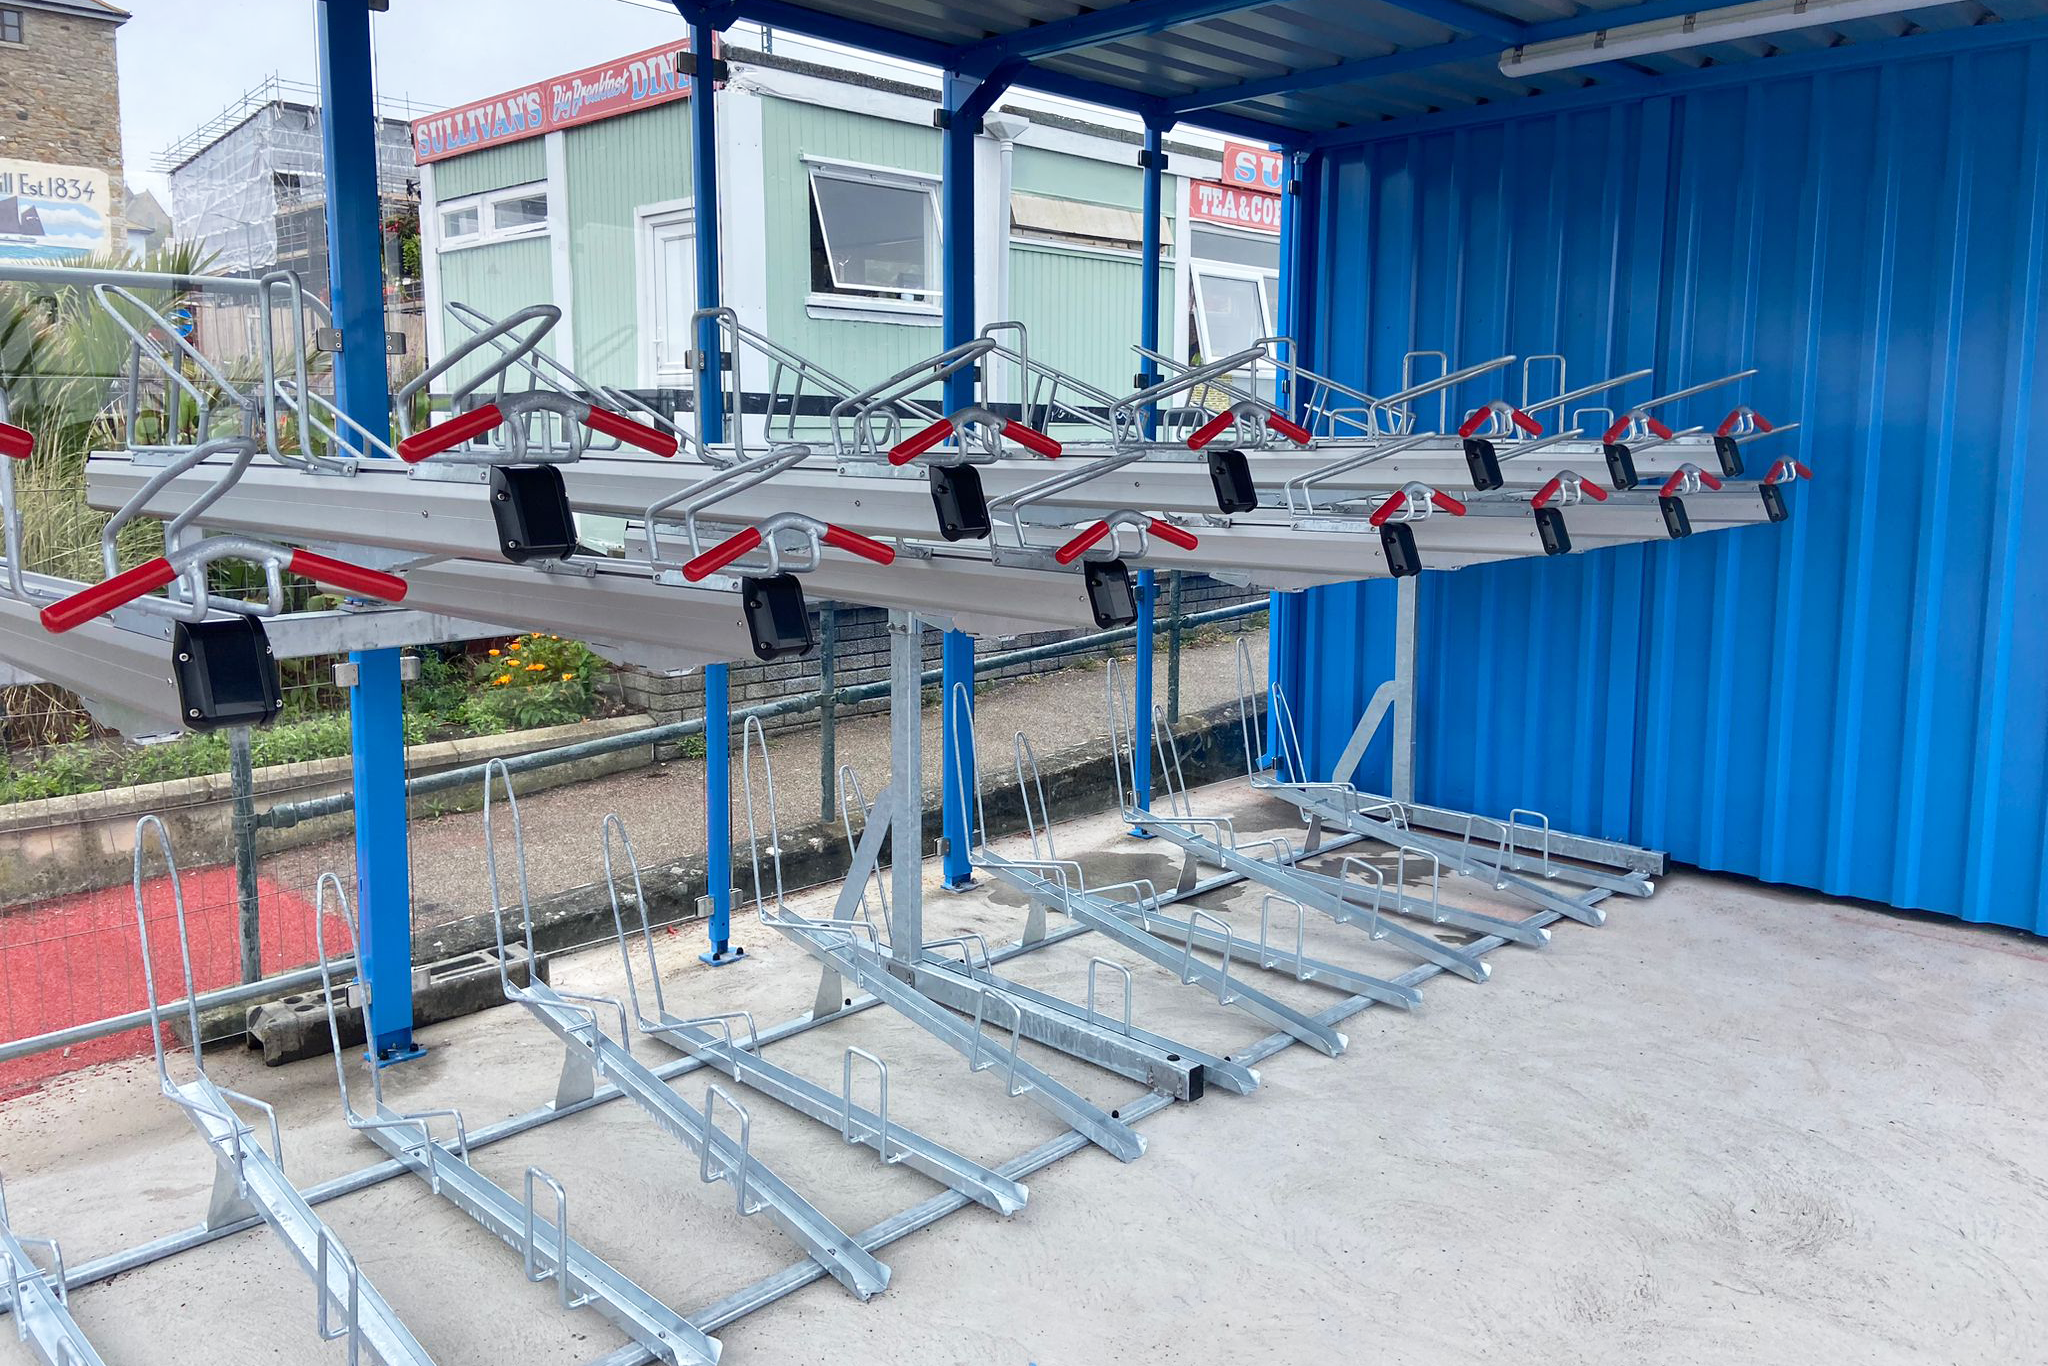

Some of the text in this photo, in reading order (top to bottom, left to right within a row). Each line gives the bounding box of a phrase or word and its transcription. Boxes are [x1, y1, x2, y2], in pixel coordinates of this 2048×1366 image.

[416, 91, 543, 157] SULLIVAN'S
[552, 84, 572, 122] Big
[571, 68, 629, 117] Breakfast
